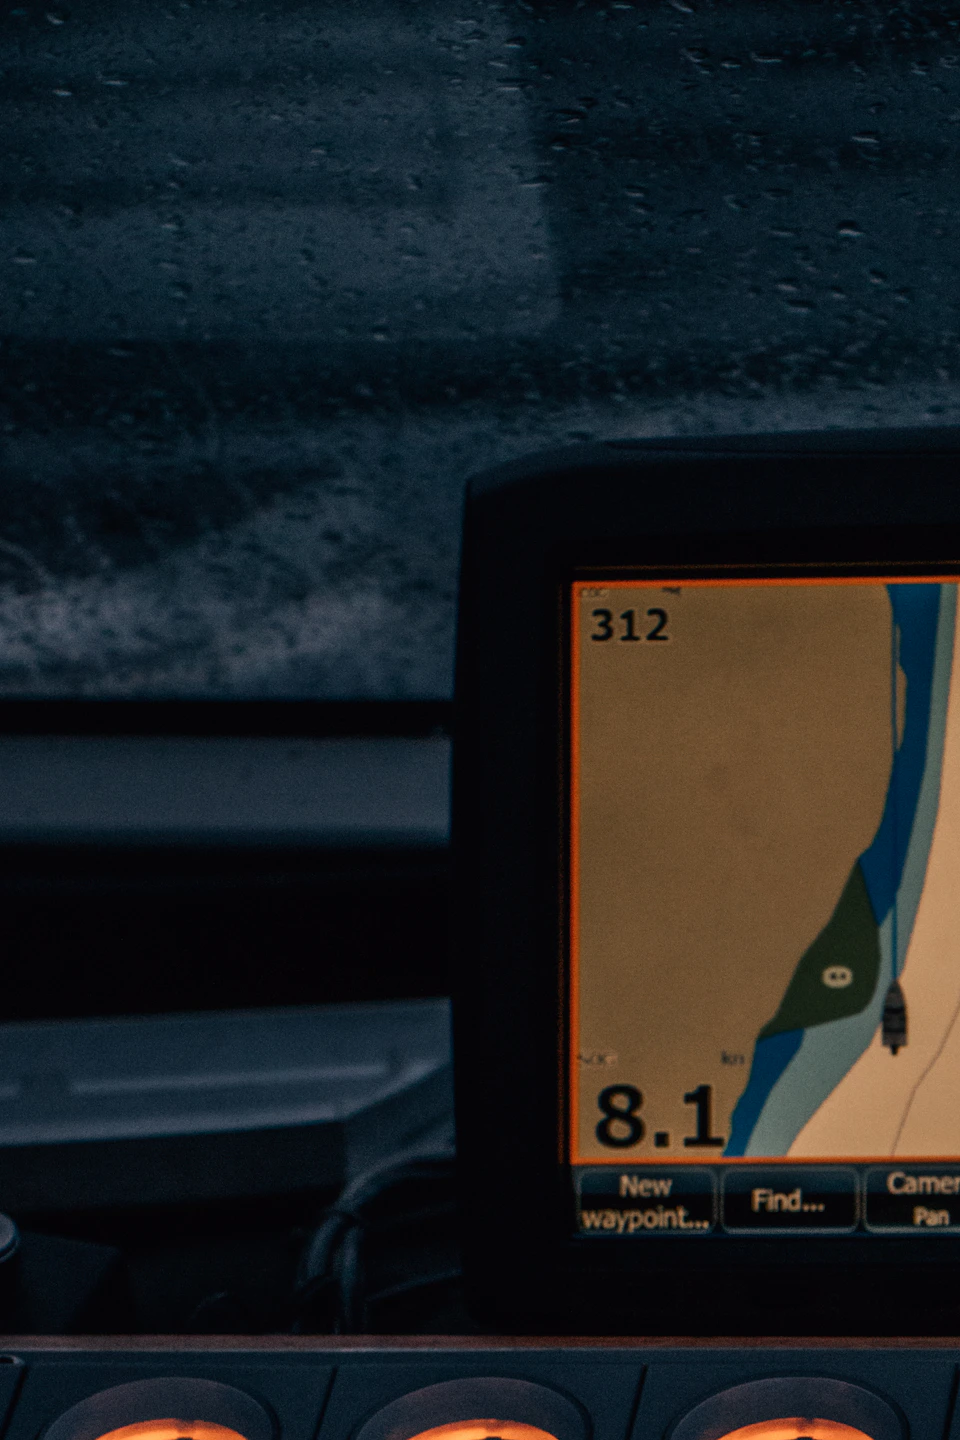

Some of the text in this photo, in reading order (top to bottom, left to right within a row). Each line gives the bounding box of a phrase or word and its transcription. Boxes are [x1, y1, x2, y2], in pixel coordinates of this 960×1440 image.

[591, 608, 668, 641] 312
[596, 1084, 724, 1147] 8.1
[618, 1174, 673, 1198] New
[751, 1187, 825, 1213] Find...
[581, 1205, 709, 1234] waypoint...
[912, 1205, 950, 1226] Pan
